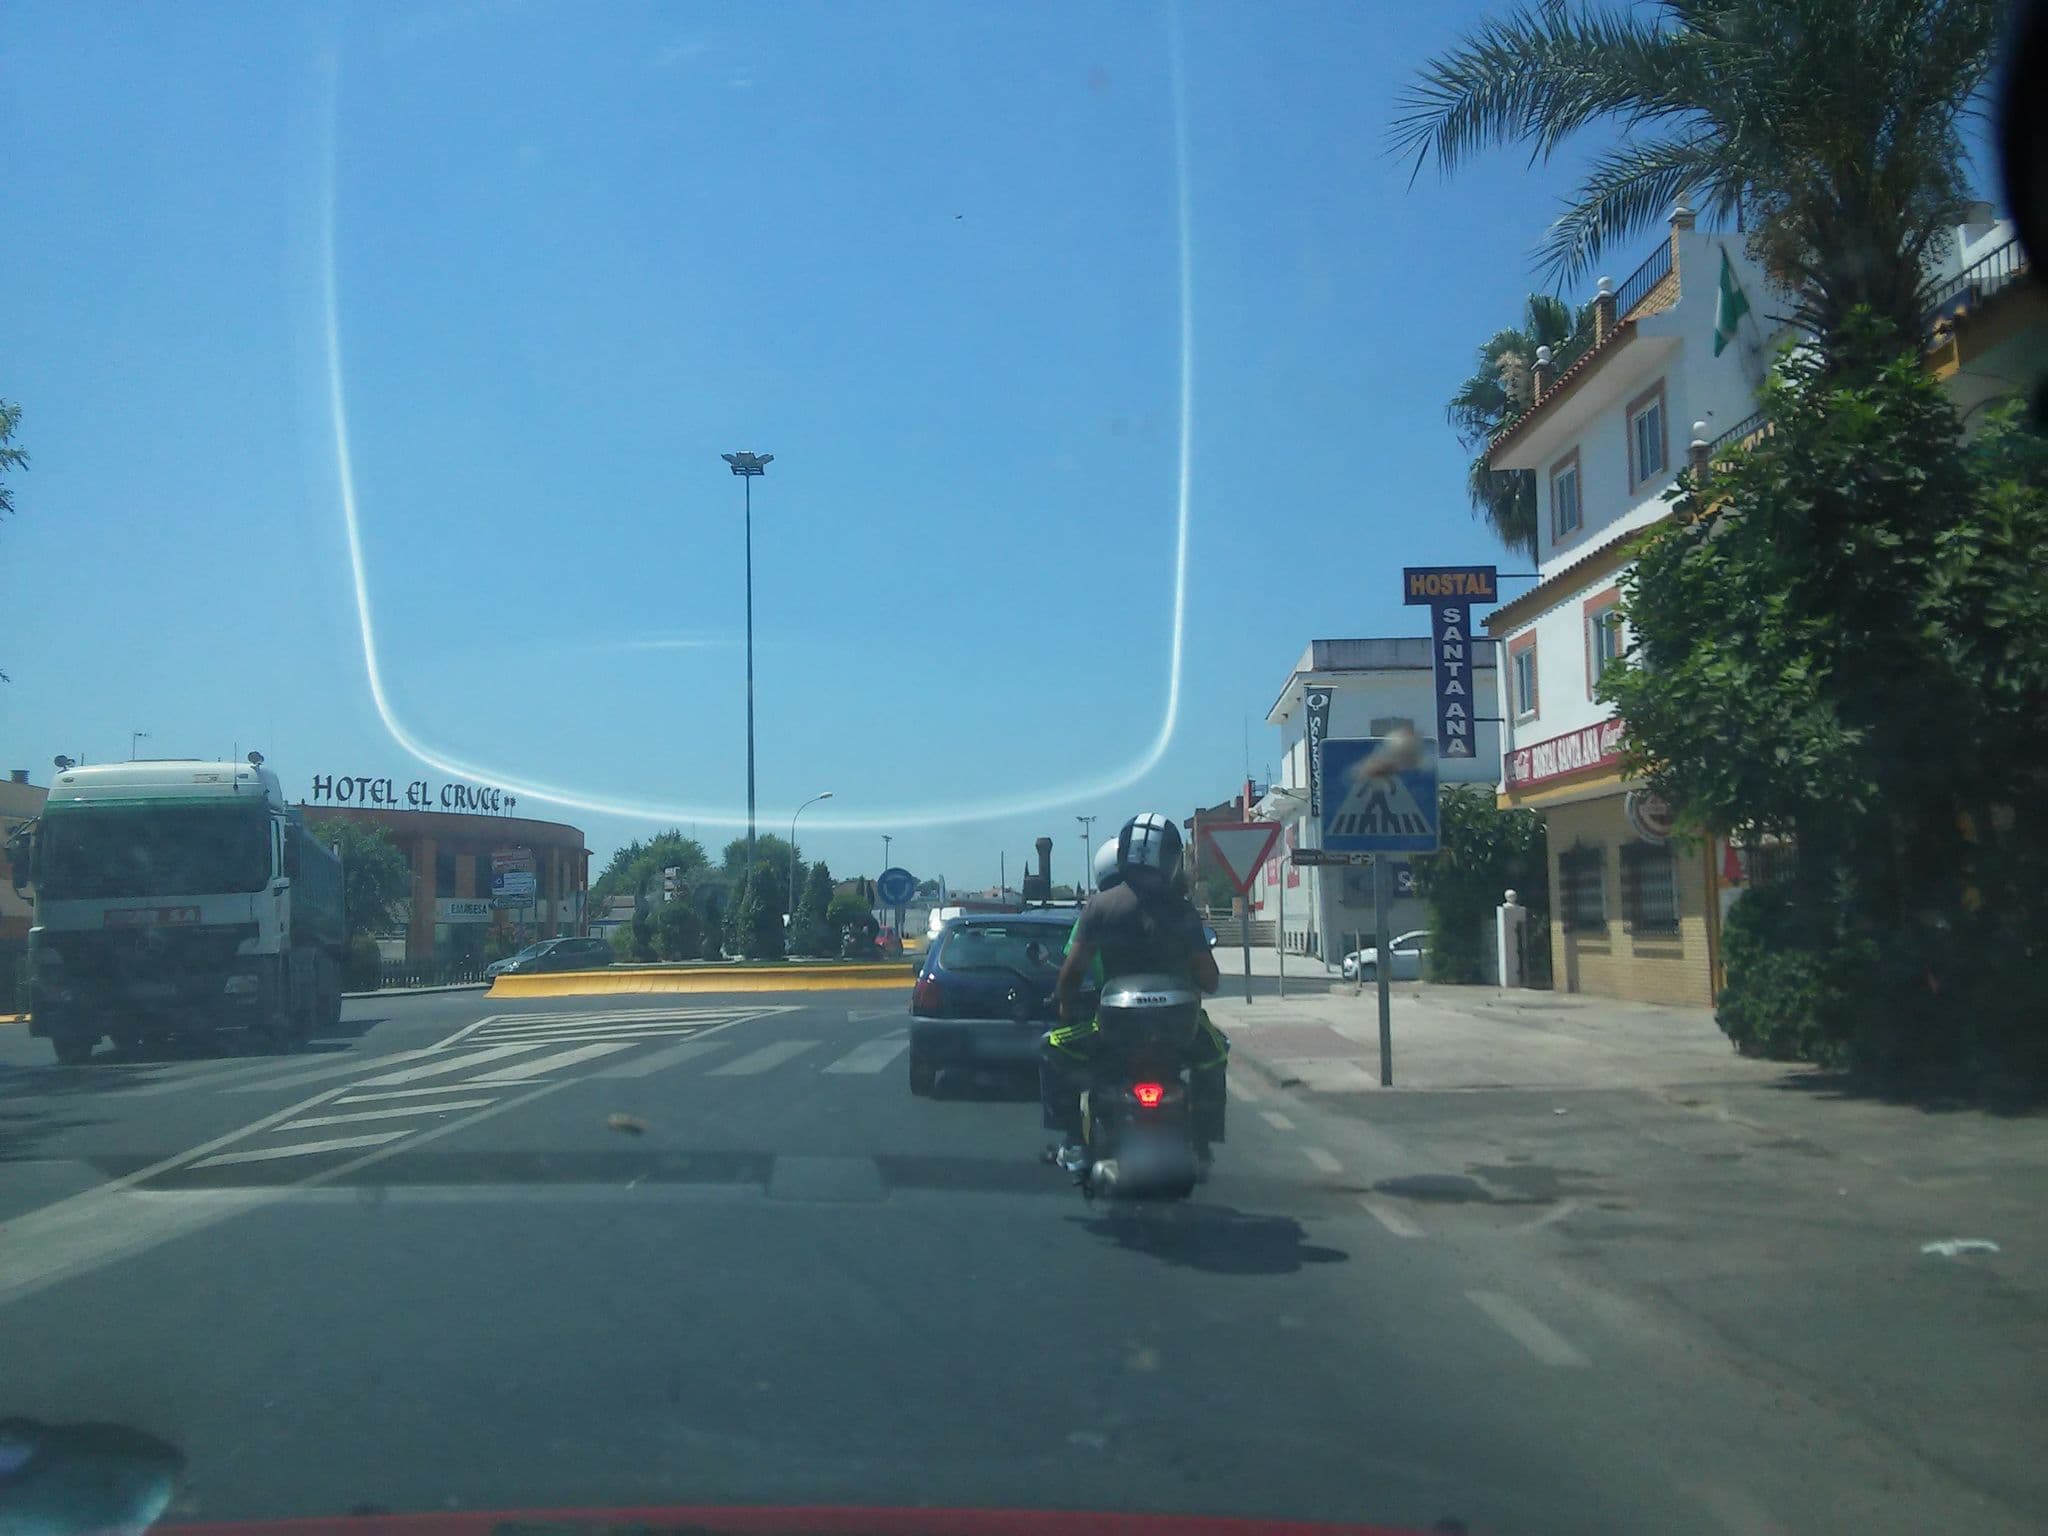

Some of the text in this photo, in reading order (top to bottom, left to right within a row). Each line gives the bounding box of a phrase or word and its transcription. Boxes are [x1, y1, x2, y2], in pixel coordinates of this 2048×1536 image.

[1410, 573, 1492, 596] HOSTAL
[1442, 608, 1467, 753] SANTA ANA
[312, 774, 500, 811] HOTEL EL CRUCE
